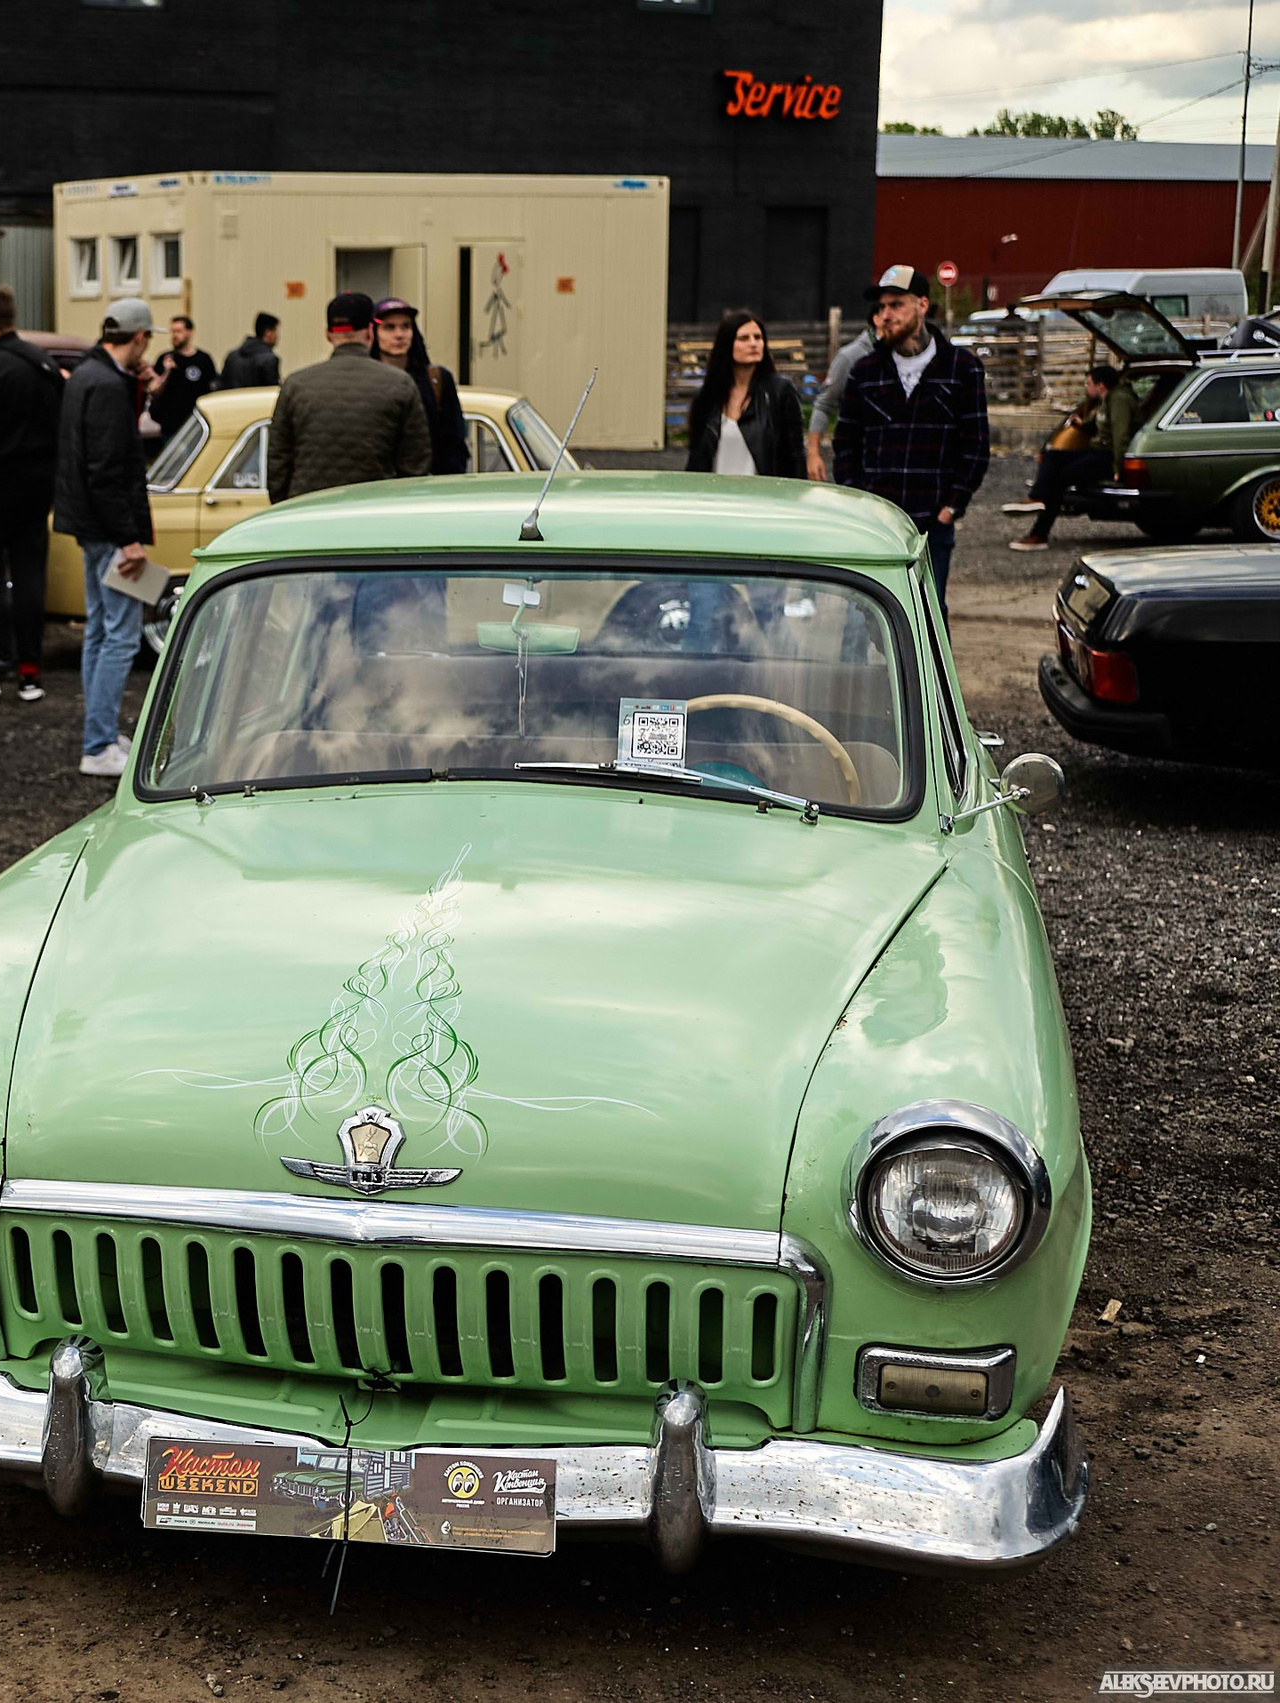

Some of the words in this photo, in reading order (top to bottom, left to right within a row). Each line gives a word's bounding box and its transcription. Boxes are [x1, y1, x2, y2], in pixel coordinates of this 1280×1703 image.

[723, 70, 841, 119] Service
[159, 1446, 260, 1480] Кастом
[160, 1476, 256, 1494] WEEKEND
[496, 1497, 544, 1508] ОРГАНИЗАТОР
